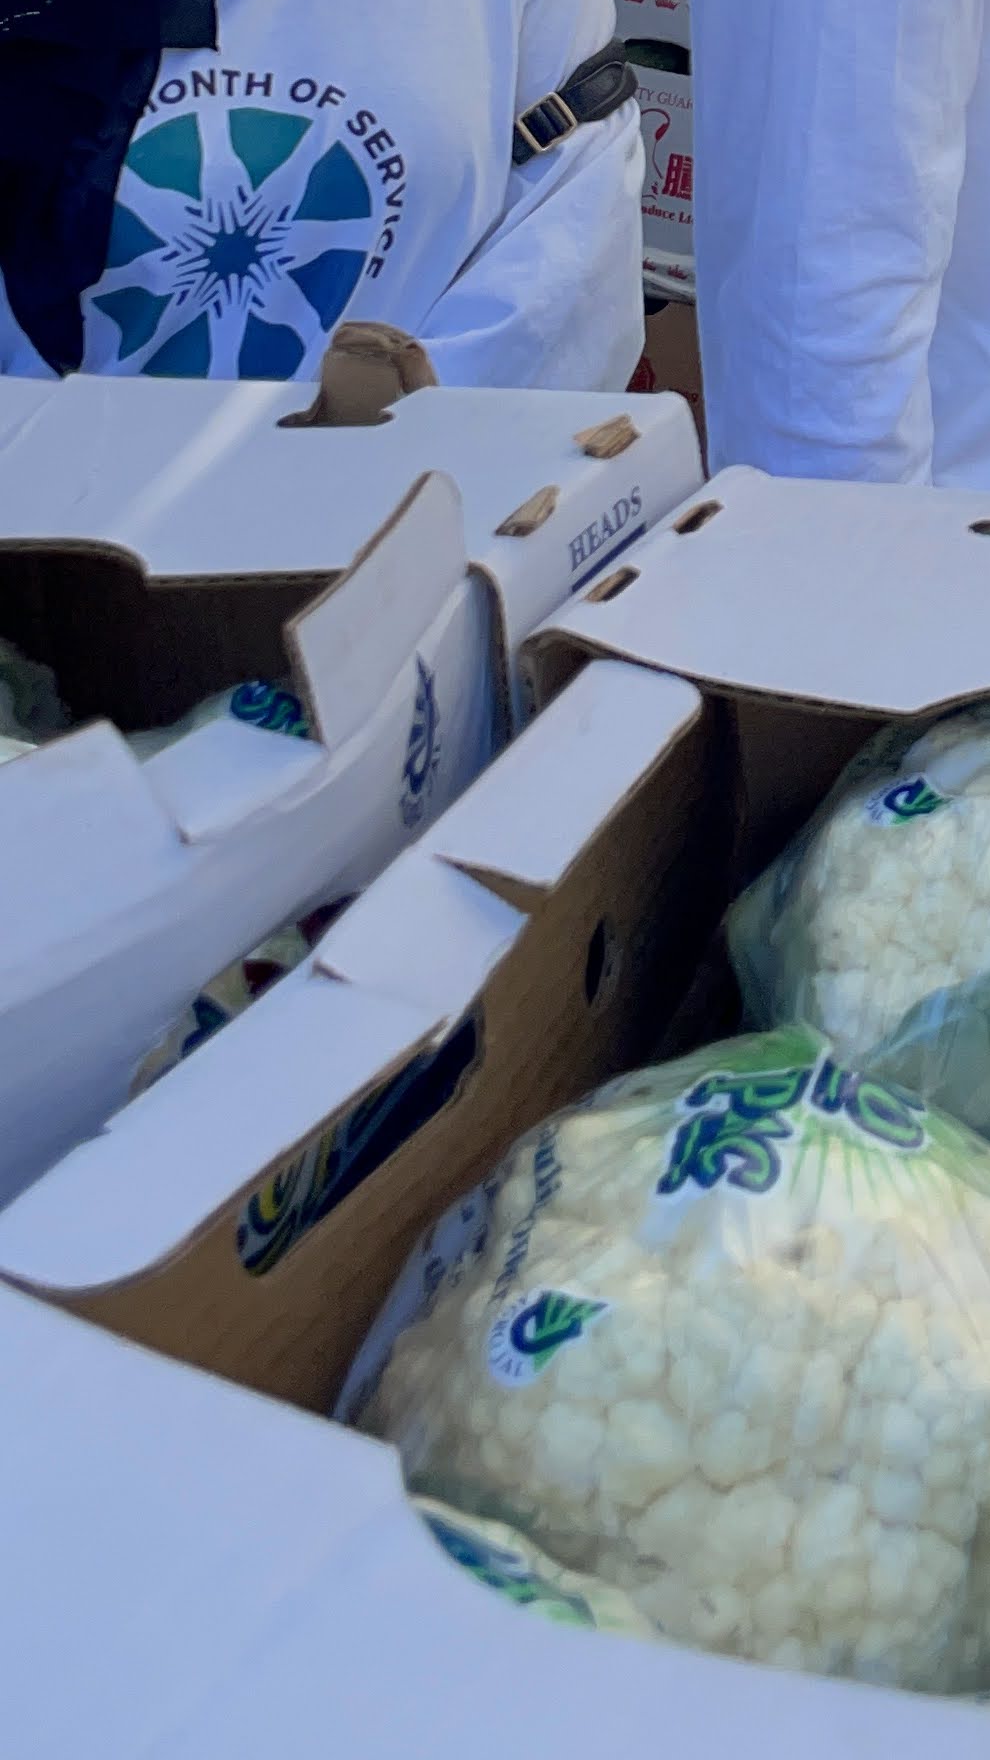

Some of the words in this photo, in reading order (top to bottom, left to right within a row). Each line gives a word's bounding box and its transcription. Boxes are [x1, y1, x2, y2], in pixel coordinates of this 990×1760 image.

[289, 77, 347, 109] OF
[346, 108, 406, 280] SERVICE
[568, 485, 642, 572] HEADS
